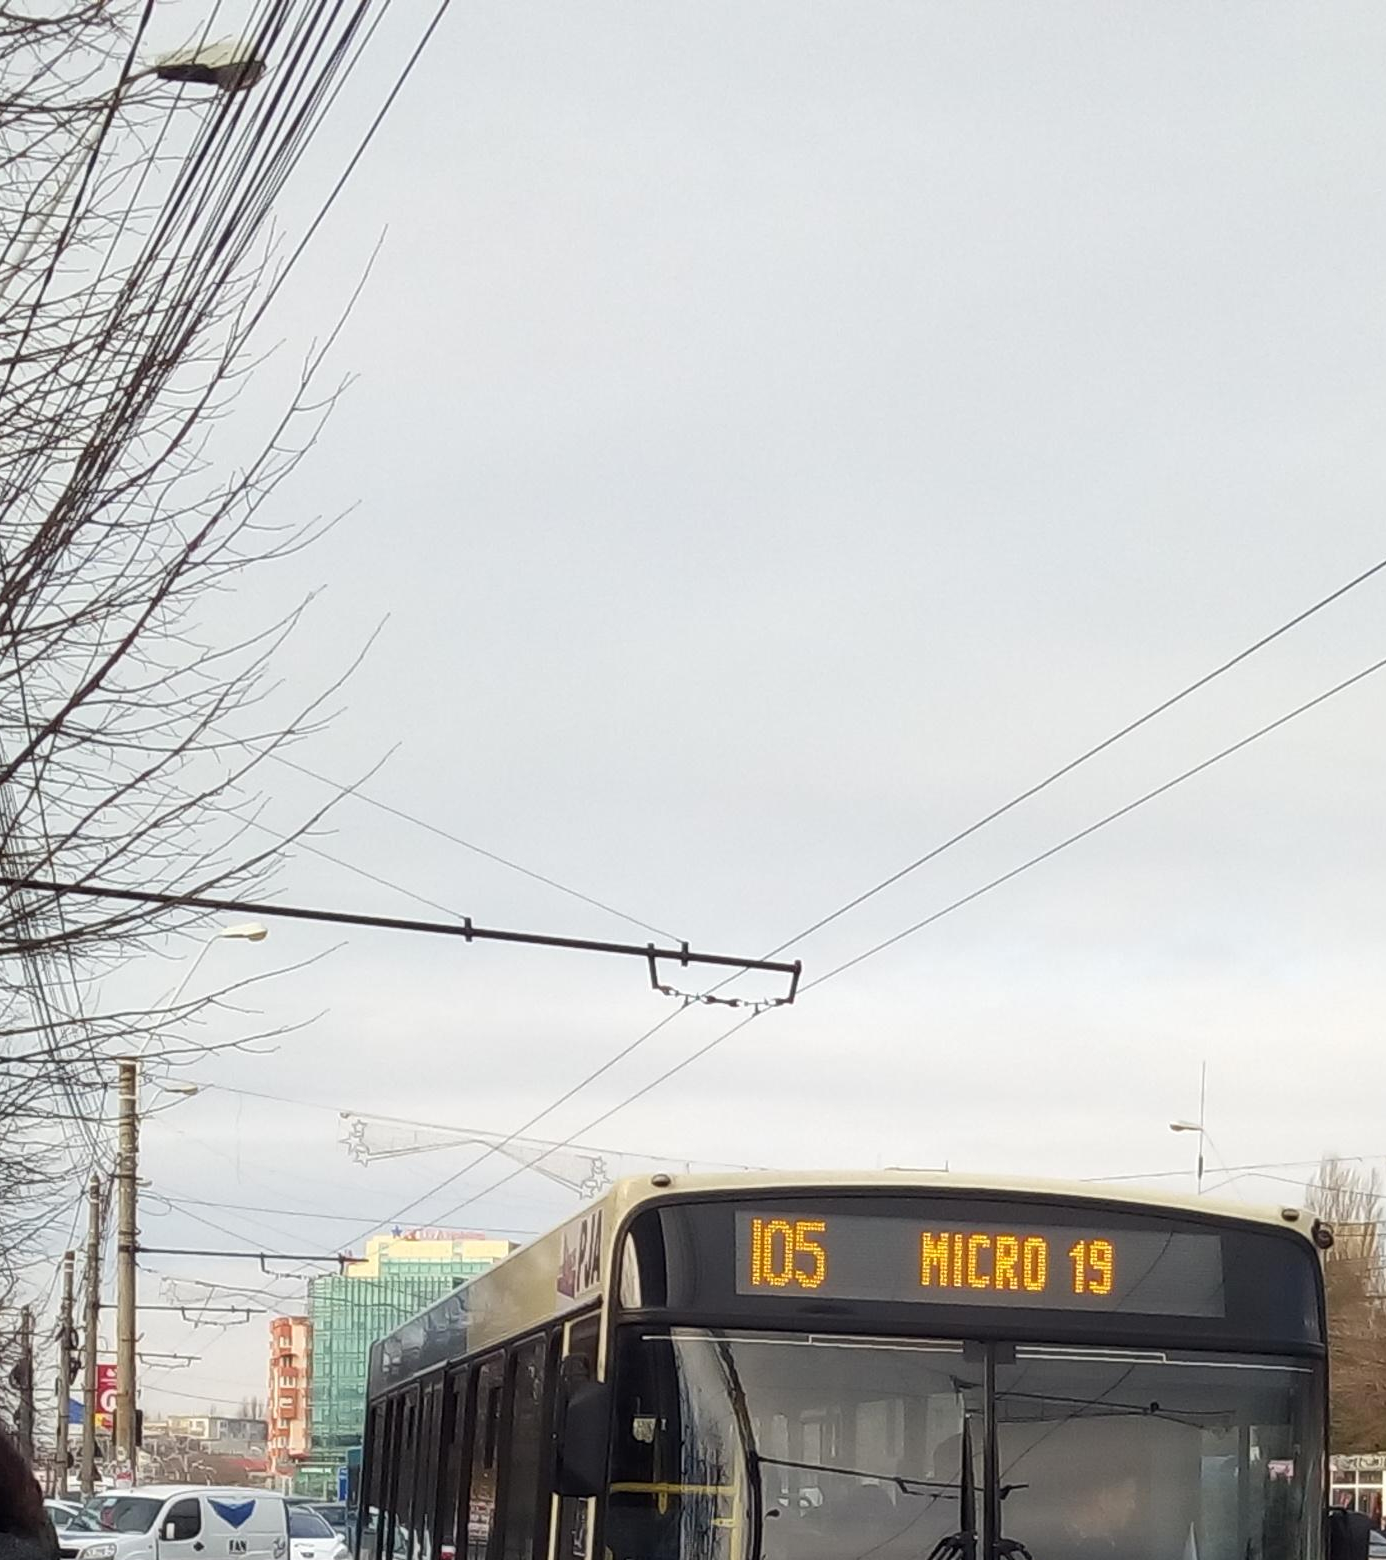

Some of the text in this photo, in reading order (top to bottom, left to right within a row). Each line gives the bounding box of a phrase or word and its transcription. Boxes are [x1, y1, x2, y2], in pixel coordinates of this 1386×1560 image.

[751, 1218, 1114, 1295] 105 MICRO 19
